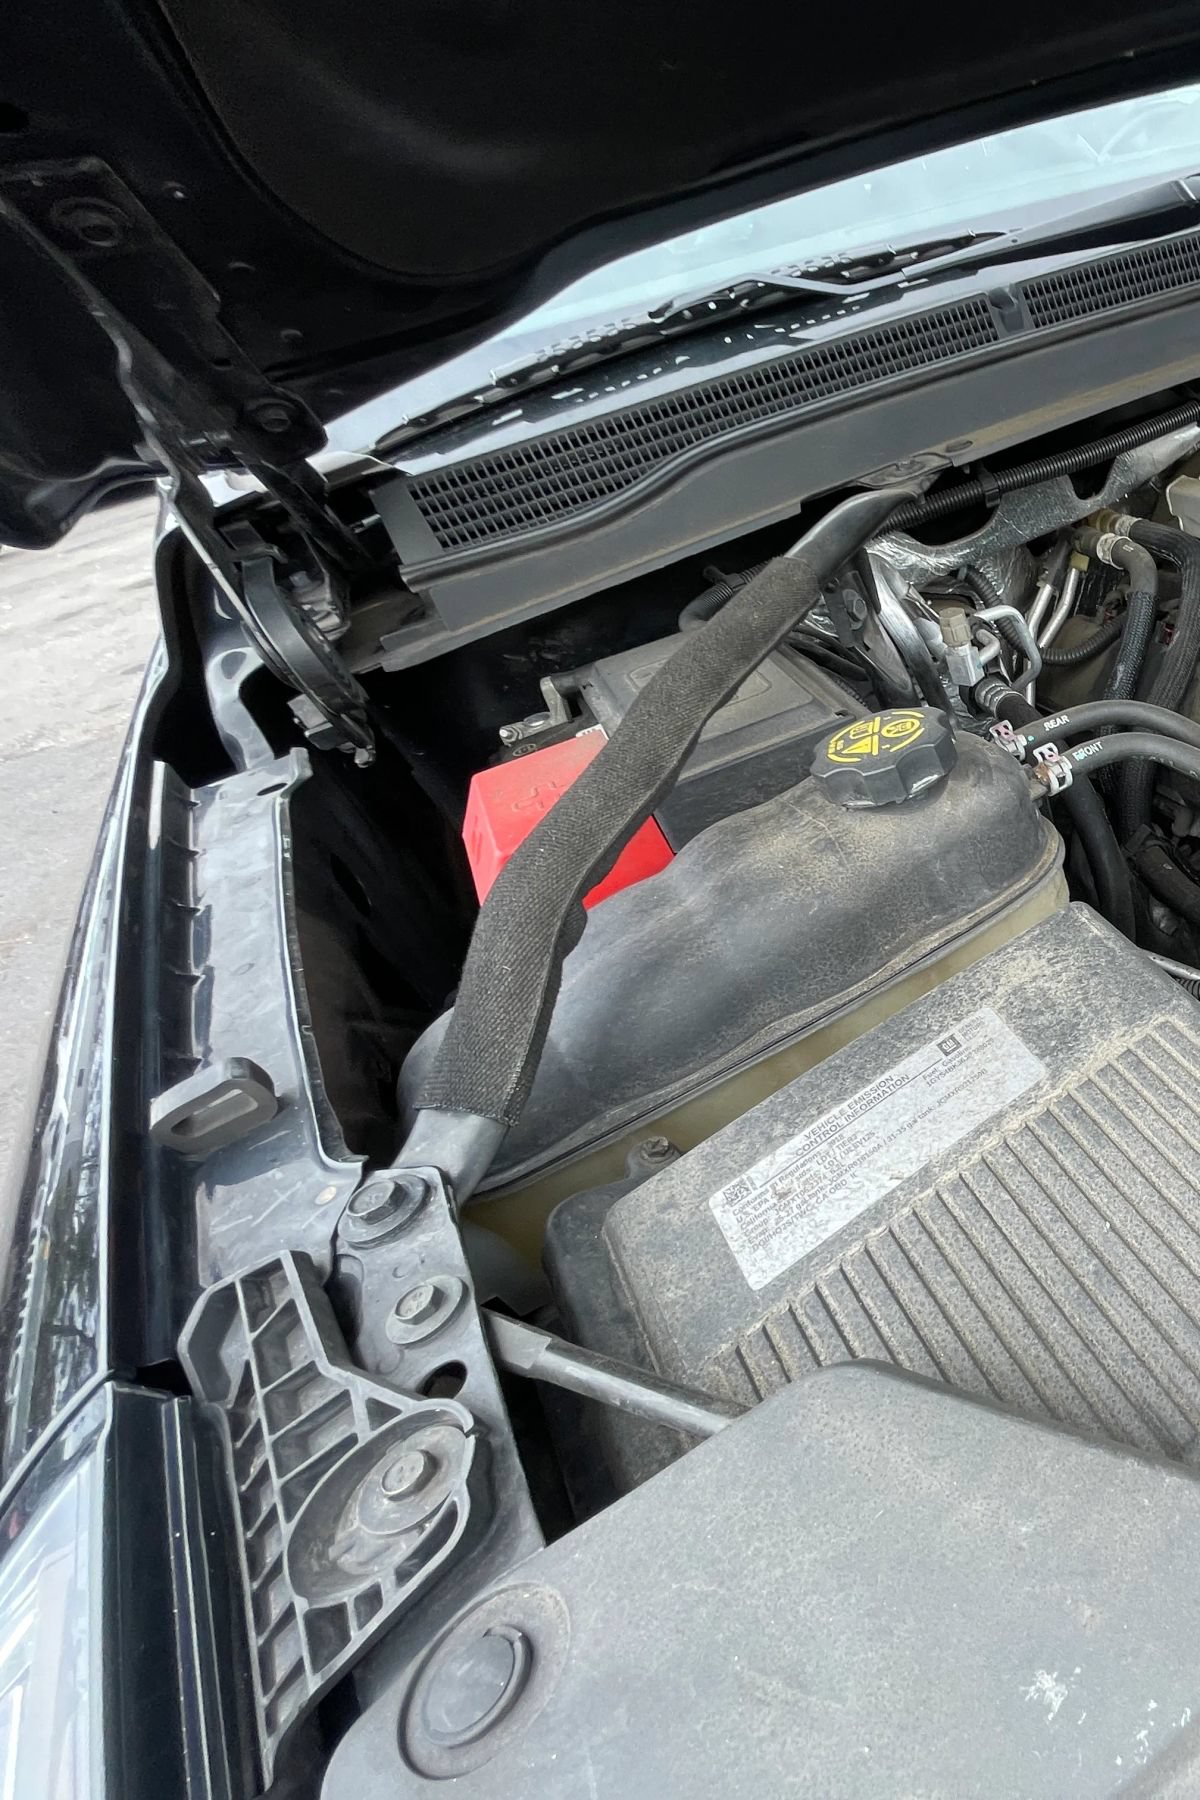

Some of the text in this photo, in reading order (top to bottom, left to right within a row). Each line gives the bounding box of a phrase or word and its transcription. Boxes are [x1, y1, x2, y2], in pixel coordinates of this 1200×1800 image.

[1043, 714, 1070, 731] REAR
[794, 1073, 910, 1157] CONTROL INFORMATION
[803, 1075, 894, 1141] VEHICLE EMISSION
[752, 1196, 769, 1212] EPA
